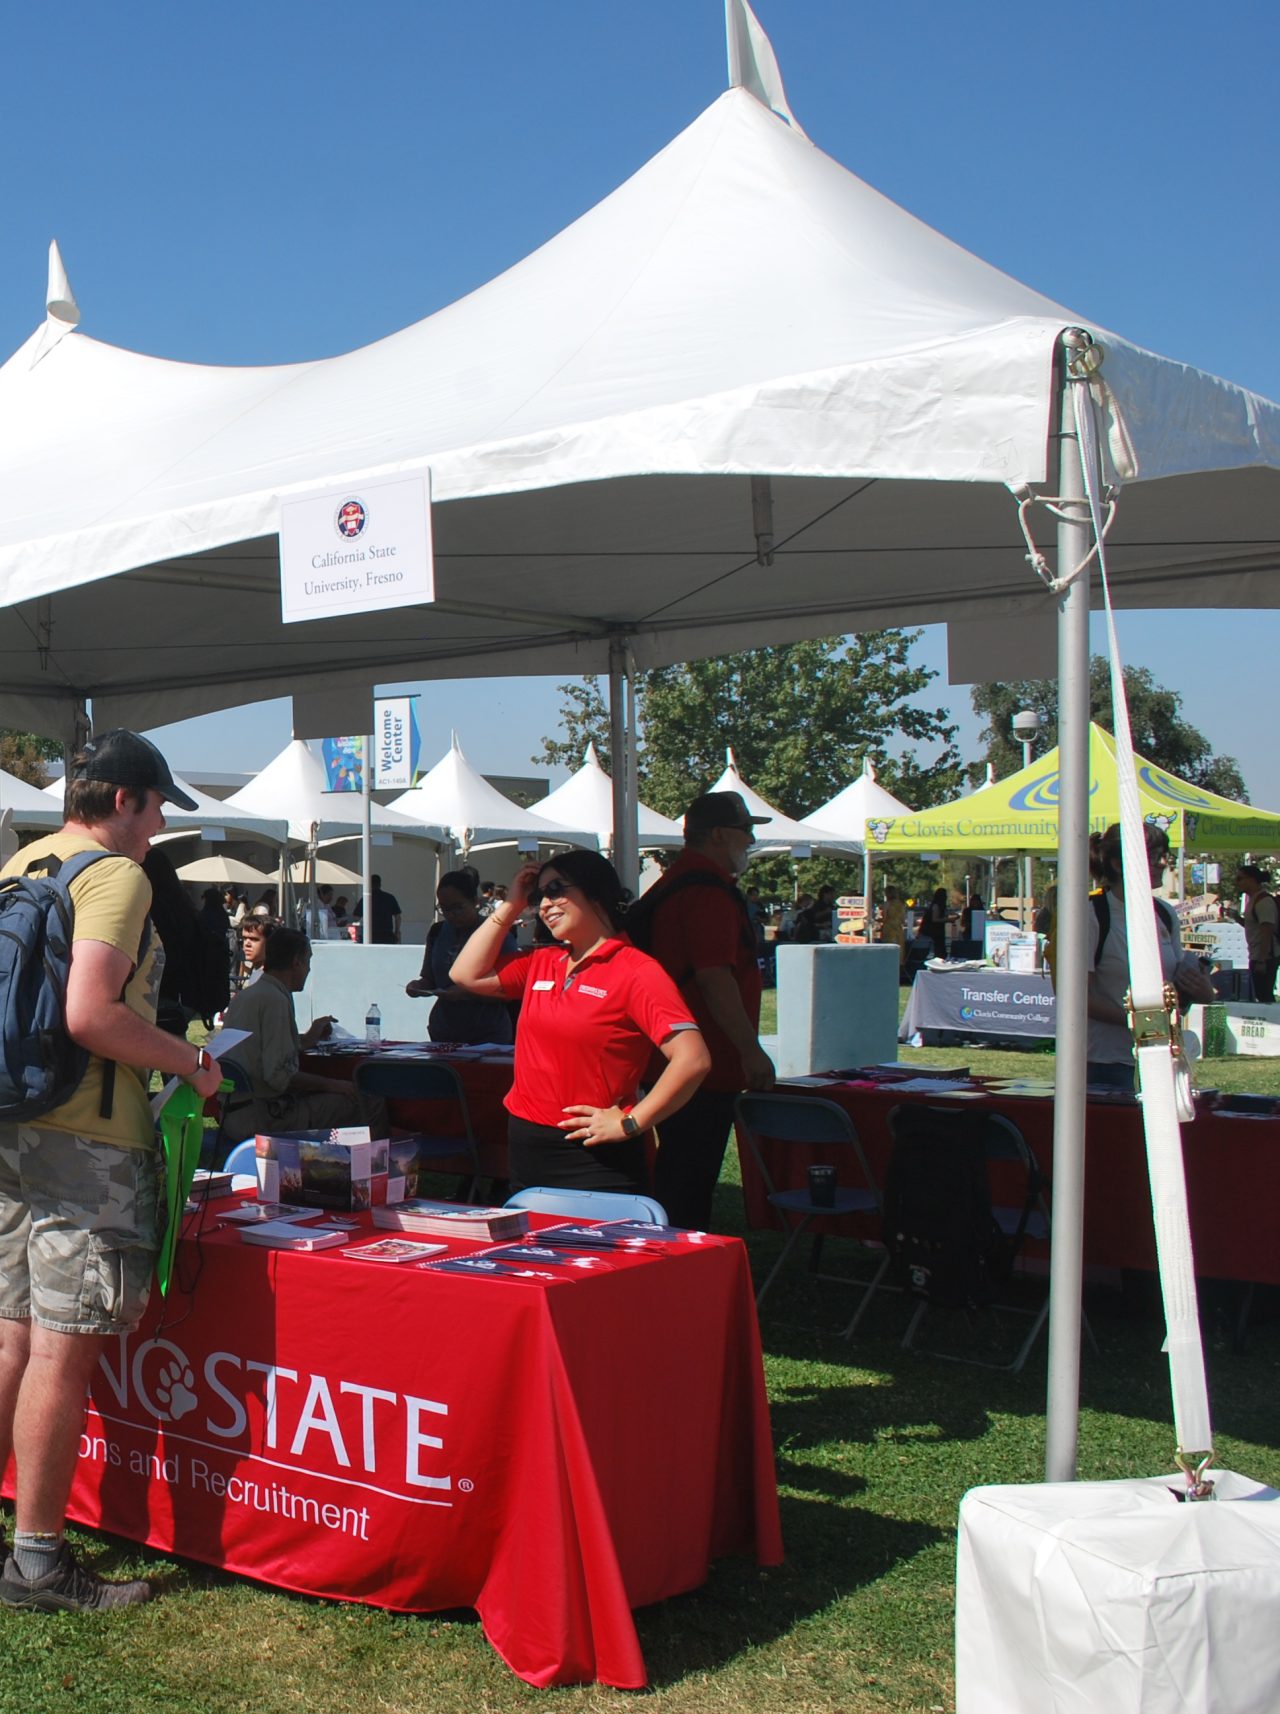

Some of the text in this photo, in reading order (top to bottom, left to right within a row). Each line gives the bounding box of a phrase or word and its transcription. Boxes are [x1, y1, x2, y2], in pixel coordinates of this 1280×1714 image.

[311, 545, 397, 569] California State
[304, 570, 404, 596] University, Fresno
[381, 709, 392, 772] Welcome
[392, 718, 403, 763] Center
[901, 818, 1059, 842] Clovis Community
[960, 988, 1055, 1006] Transfer Center
[992, 1011, 1027, 1022] Community
[1027, 1013, 1050, 1023] College
[1241, 1025, 1265, 1038] BREAD
[203, 1351, 452, 1490] STATE
[130, 1448, 180, 1484] and
[191, 1458, 370, 1541] Recruitment
